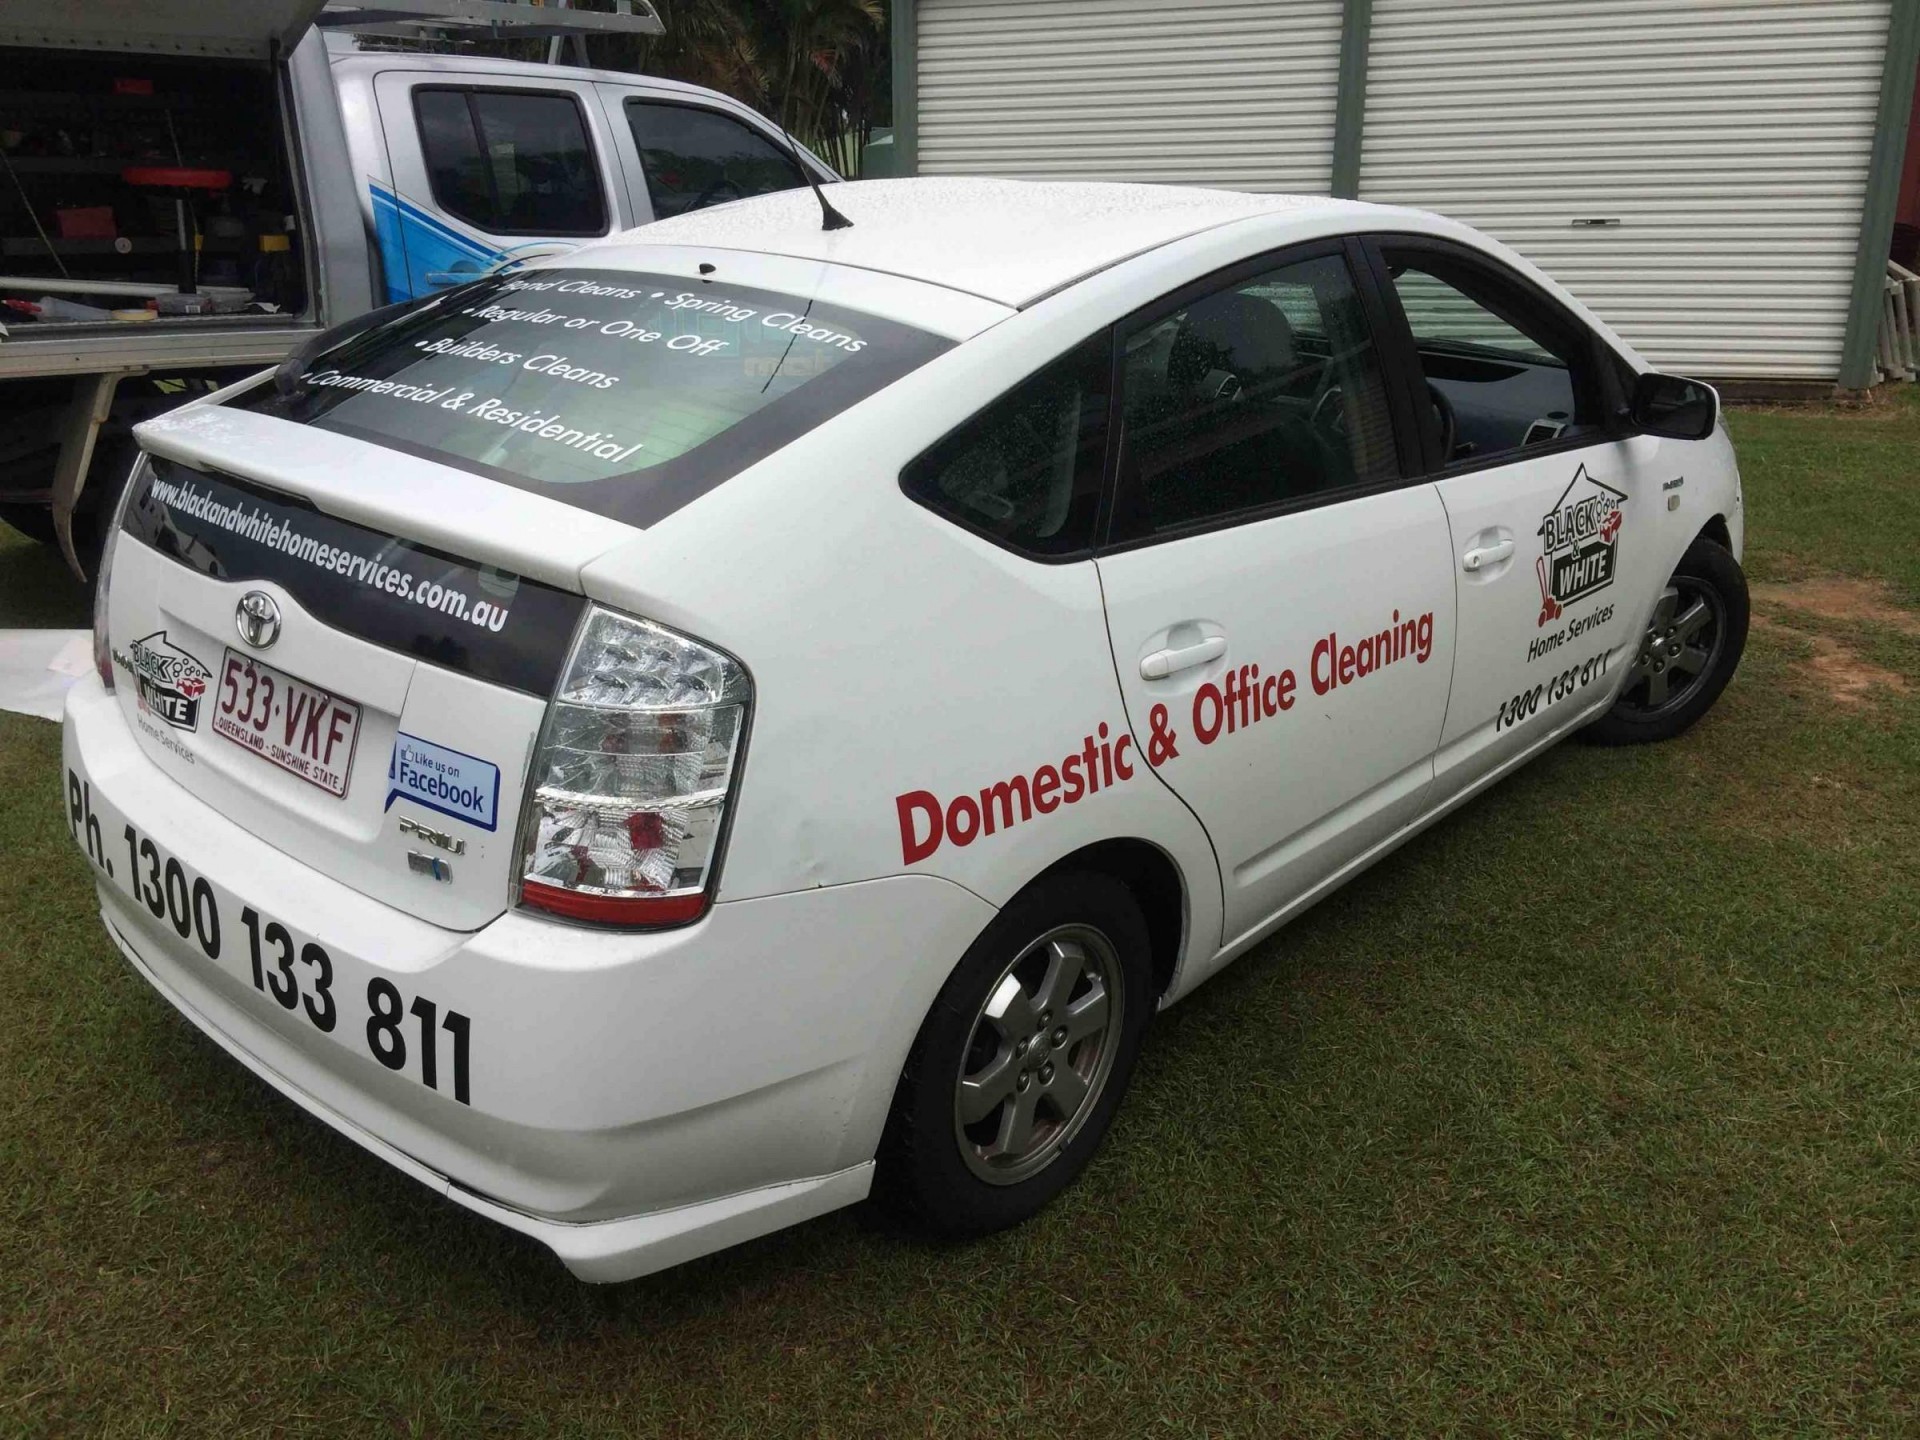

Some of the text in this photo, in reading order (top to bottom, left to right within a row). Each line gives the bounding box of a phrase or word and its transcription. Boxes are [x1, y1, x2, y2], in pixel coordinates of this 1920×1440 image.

[471, 305, 729, 356] Regular or One Off
[558, 280, 641, 299] Cleans
[664, 292, 757, 322] Spring
[761, 312, 867, 352] Cleans
[422, 338, 620, 389] Builders Cleans
[307, 370, 643, 463] Commercial & Residential
[1543, 496, 1599, 555] BLACK
[1572, 539, 1581, 558] &
[150, 478, 508, 632] www.blackandwhitehomeservices.com.au
[1560, 549, 1608, 597] WHITE
[1527, 603, 1615, 663] Home Services
[132, 640, 176, 684] BLACK
[1496, 648, 1612, 732] 1300 133 811
[143, 682, 188, 721] WHITE
[137, 713, 195, 765] Home Services
[218, 716, 265, 751] QUEENSLAND
[270, 744, 311, 775] SUNSHINE
[313, 766, 339, 789] STATE
[896, 609, 1434, 866] Domestic & Office Cleaning
[400, 761, 484, 814] Facebook
[414, 753, 460, 779] Like us on
[69, 768, 471, 1106] Ph. 1300 133 811
